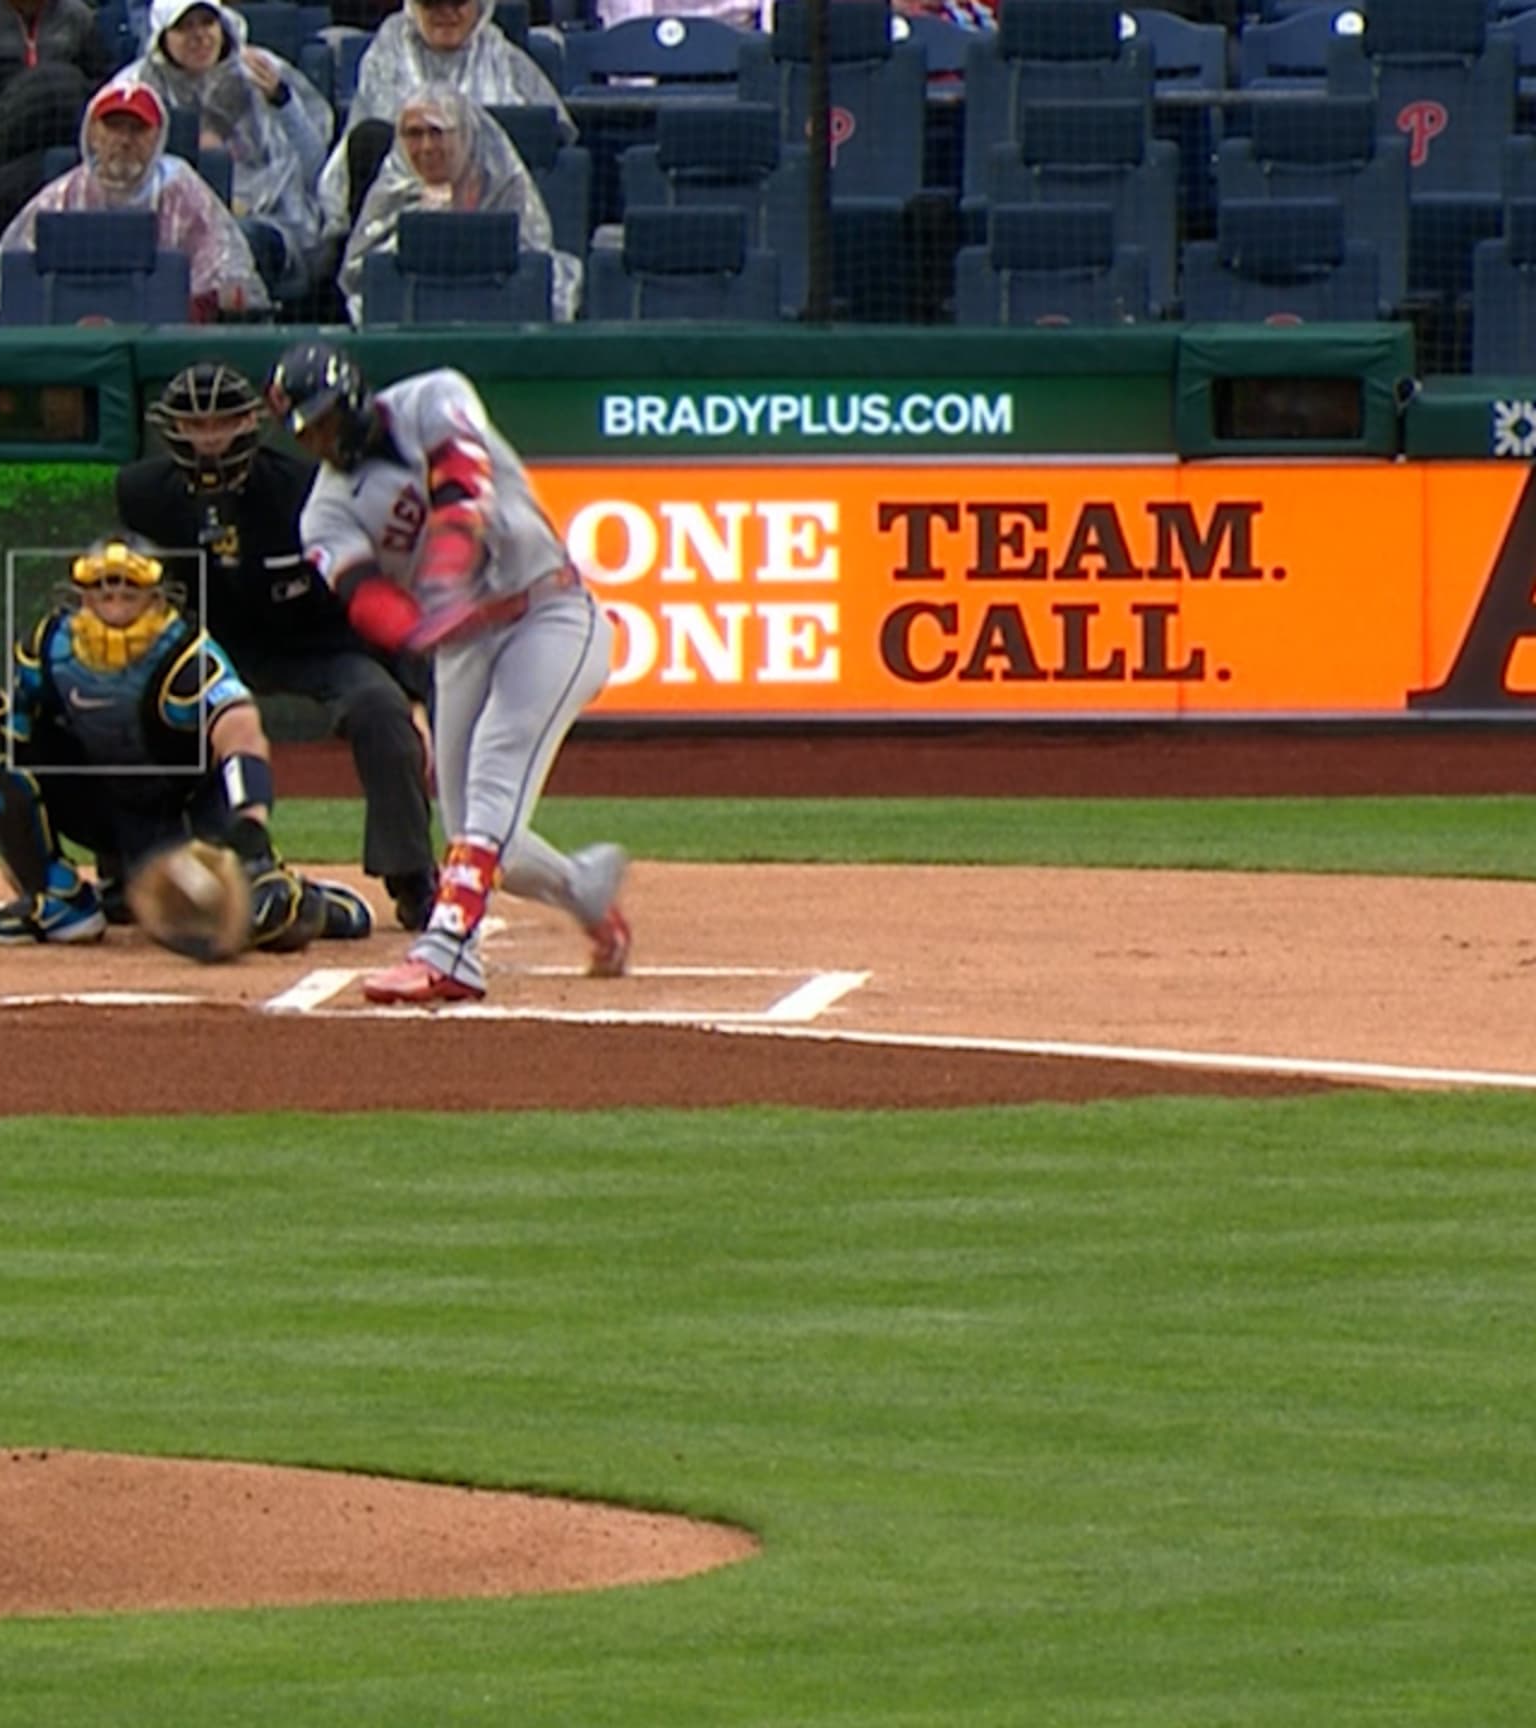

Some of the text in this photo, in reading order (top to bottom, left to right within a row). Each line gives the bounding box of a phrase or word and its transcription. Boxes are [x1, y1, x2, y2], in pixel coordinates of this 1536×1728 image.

[1396, 100, 1448, 167] P
[602, 393, 1013, 435] BRADYPLUS.COM
[566, 500, 1288, 584] ONE TEAM.
[878, 600, 1233, 684] CALL.
